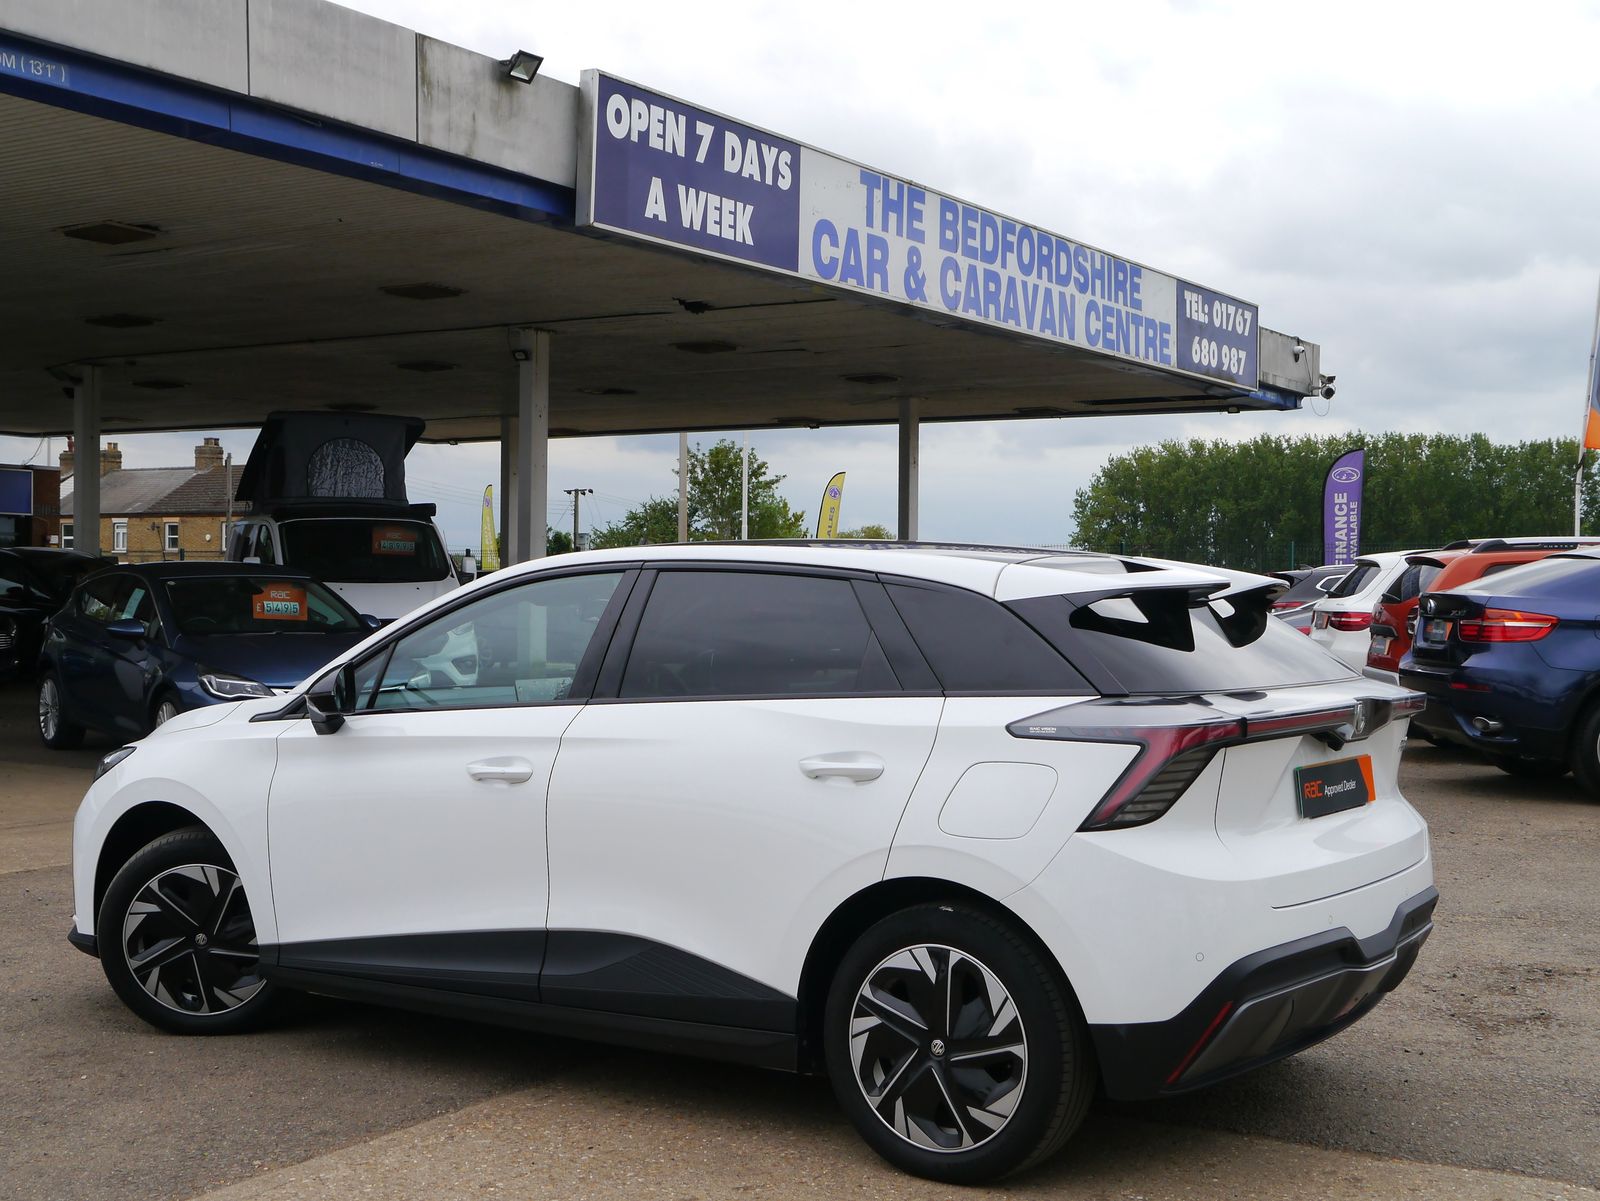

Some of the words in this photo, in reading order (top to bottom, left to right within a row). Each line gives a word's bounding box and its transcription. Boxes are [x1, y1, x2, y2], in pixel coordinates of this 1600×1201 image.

[0, 52, 16, 69] M
[606, 93, 687, 158] OPEN
[695, 120, 715, 164] 7
[723, 130, 792, 191] DAYS
[644, 176, 668, 222] A
[677, 183, 754, 246] WEEK
[859, 169, 926, 245] THE
[939, 197, 1143, 311] BEDFORDSHIRE
[812, 218, 890, 294] CAR
[903, 245, 928, 302] &
[939, 256, 1076, 341] CARAVAN
[1084, 299, 1172, 366] CENTRE
[1184, 289, 1209, 324] TEL:
[1212, 300, 1252, 336] 01767
[1191, 335, 1218, 368] 680
[1221, 344, 1247, 376] 987
[827, 506, 835, 538] ALES
[1324, 781, 1344, 798] Approved
[1343, 779, 1357, 791] Dealer
